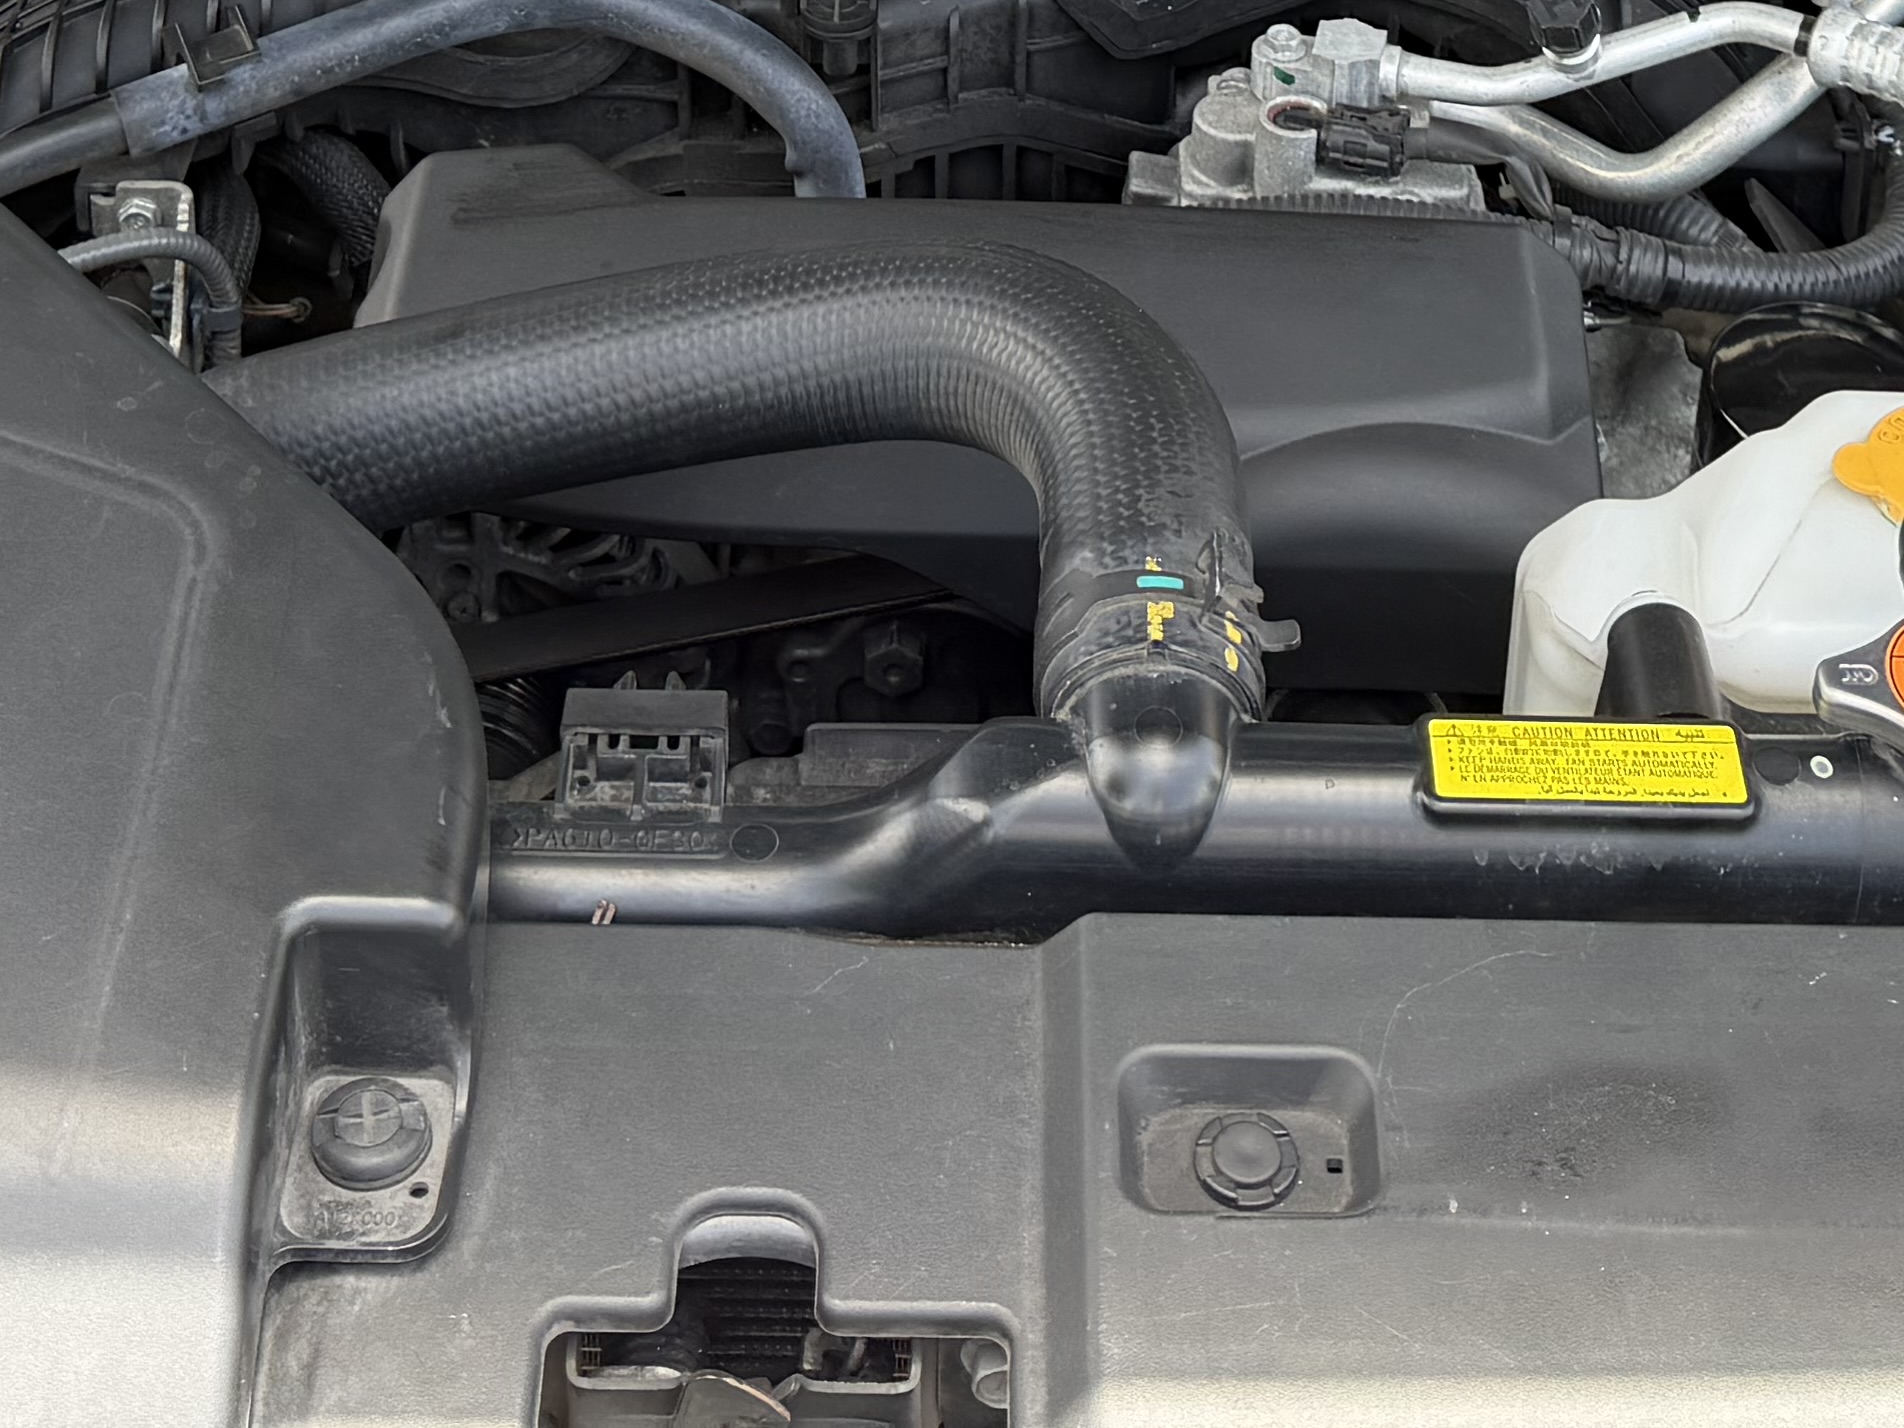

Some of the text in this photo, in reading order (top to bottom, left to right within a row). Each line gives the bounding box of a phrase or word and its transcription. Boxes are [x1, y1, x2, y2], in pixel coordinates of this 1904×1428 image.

[1511, 725, 1572, 738] CAUTION
[1584, 727, 1659, 740] ATTENTION
[1458, 755, 1485, 763] KEEP
[1489, 756, 1525, 764] HANDS
[1631, 759, 1717, 769] AUTOMATICALLY.
